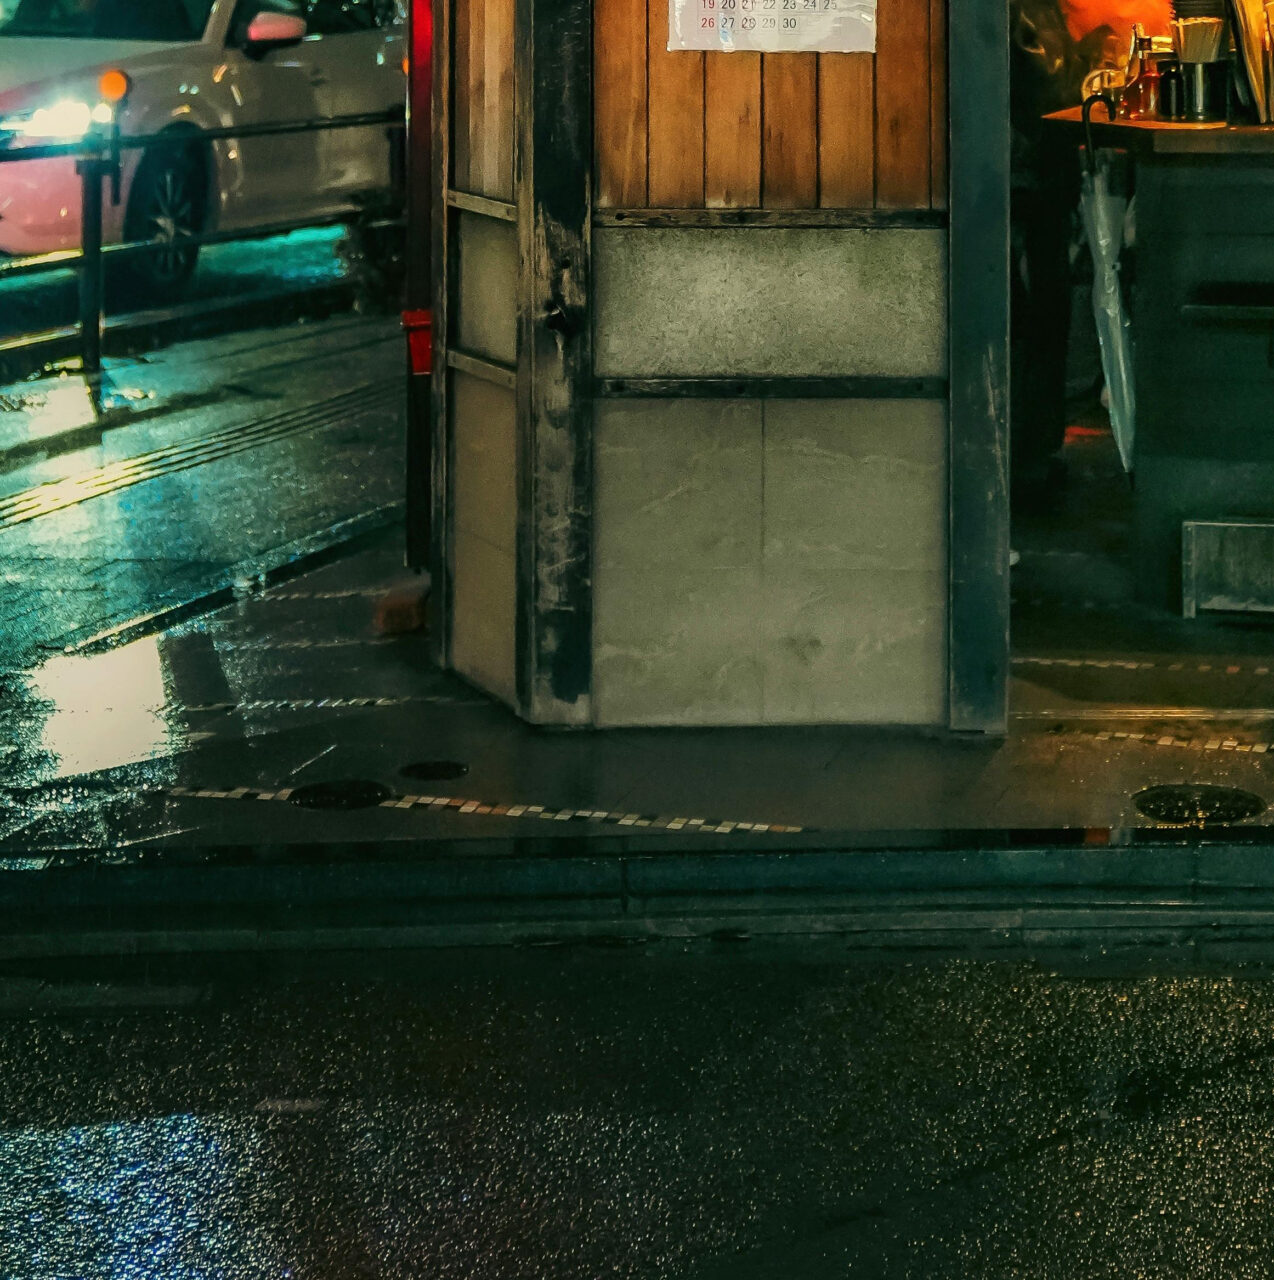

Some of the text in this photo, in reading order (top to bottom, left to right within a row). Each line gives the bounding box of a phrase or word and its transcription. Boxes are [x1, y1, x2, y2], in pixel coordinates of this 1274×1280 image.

[703, 0, 837, 10] 19 20 21 22 23 24 25
[702, 17, 796, 28] 26 27 28 29 30
